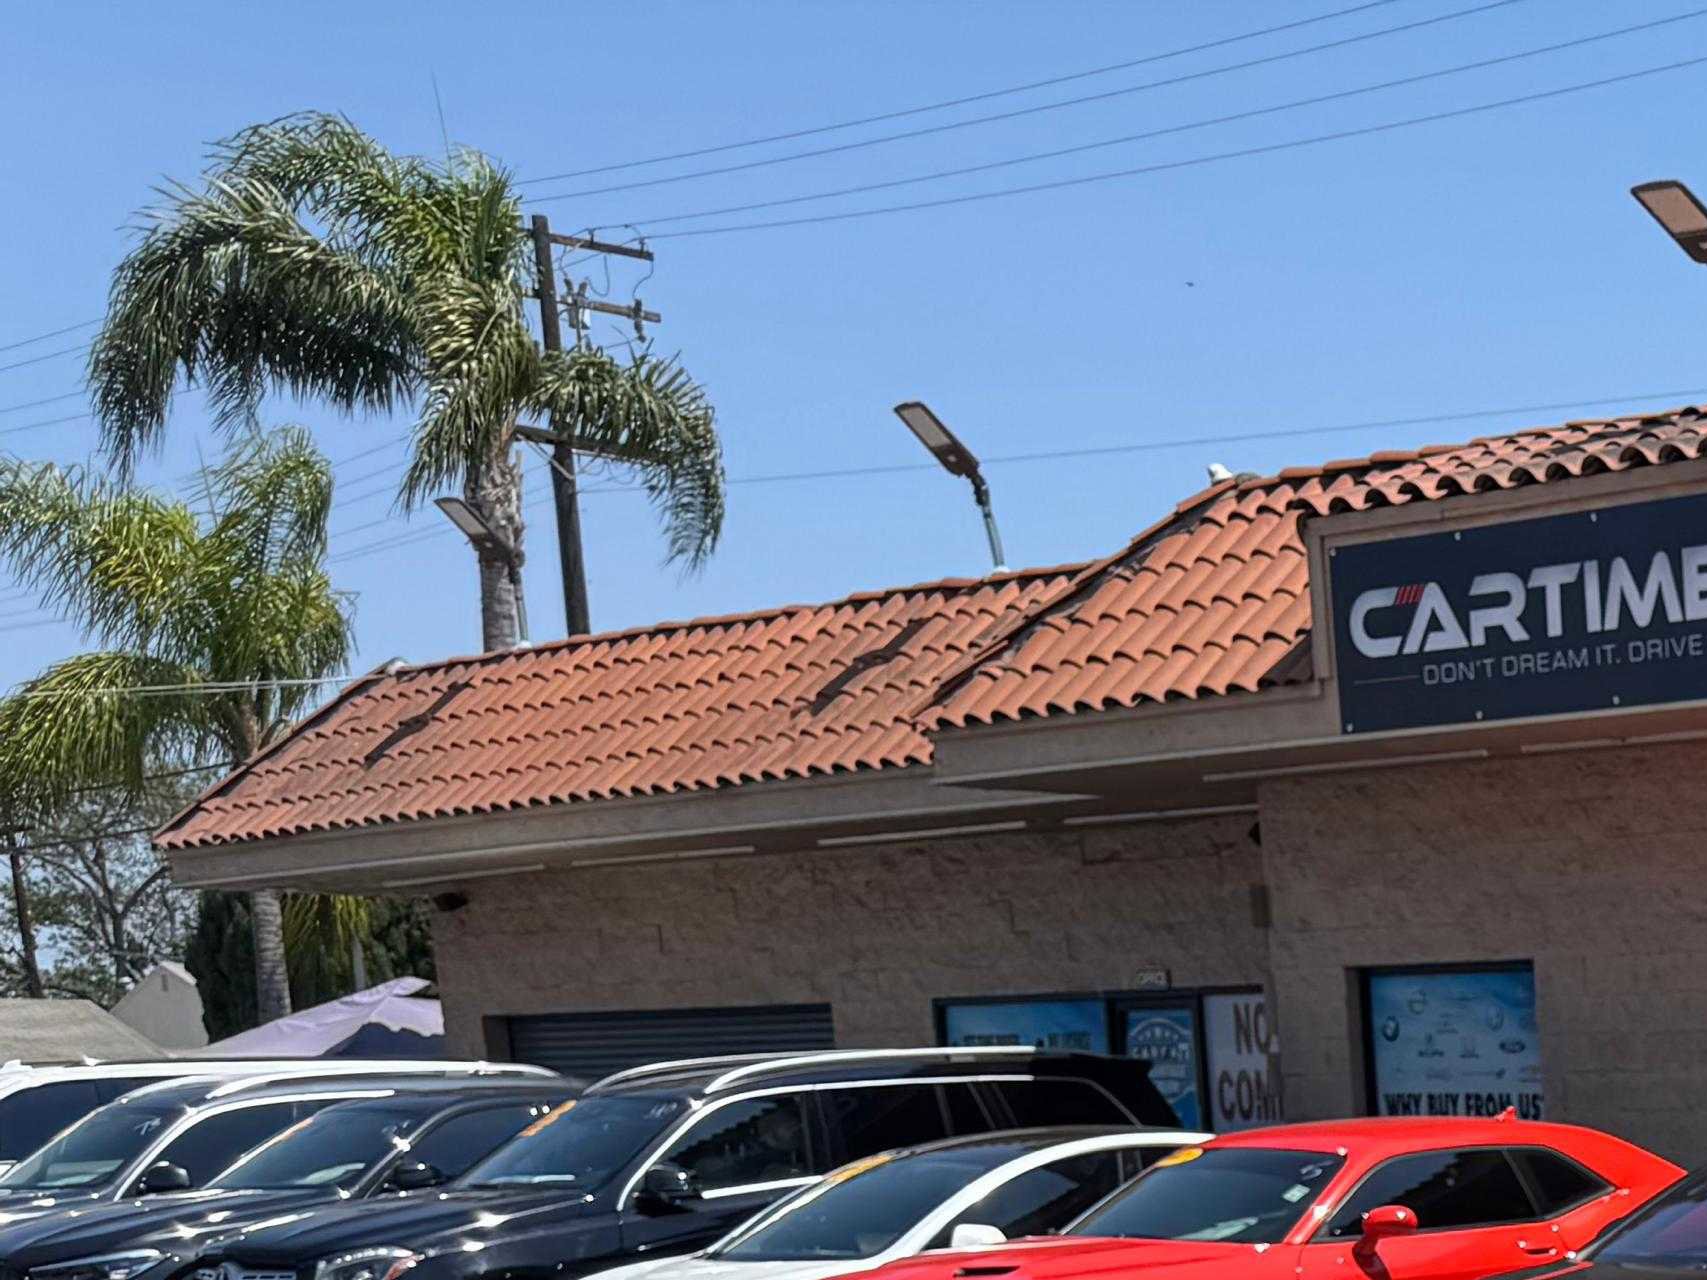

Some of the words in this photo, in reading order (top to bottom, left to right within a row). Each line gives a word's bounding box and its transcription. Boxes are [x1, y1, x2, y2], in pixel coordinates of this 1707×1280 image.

[1423, 656, 1496, 687] DON'T
[1502, 647, 1589, 676] DREAM
[1595, 645, 1623, 667] IT.
[1629, 633, 1705, 663] DRIVE
[1233, 1003, 1272, 1054] NO
[1383, 1092, 1422, 1116] WHY
[1426, 1092, 1459, 1116] BUY
[1464, 1092, 1512, 1117] FROM
